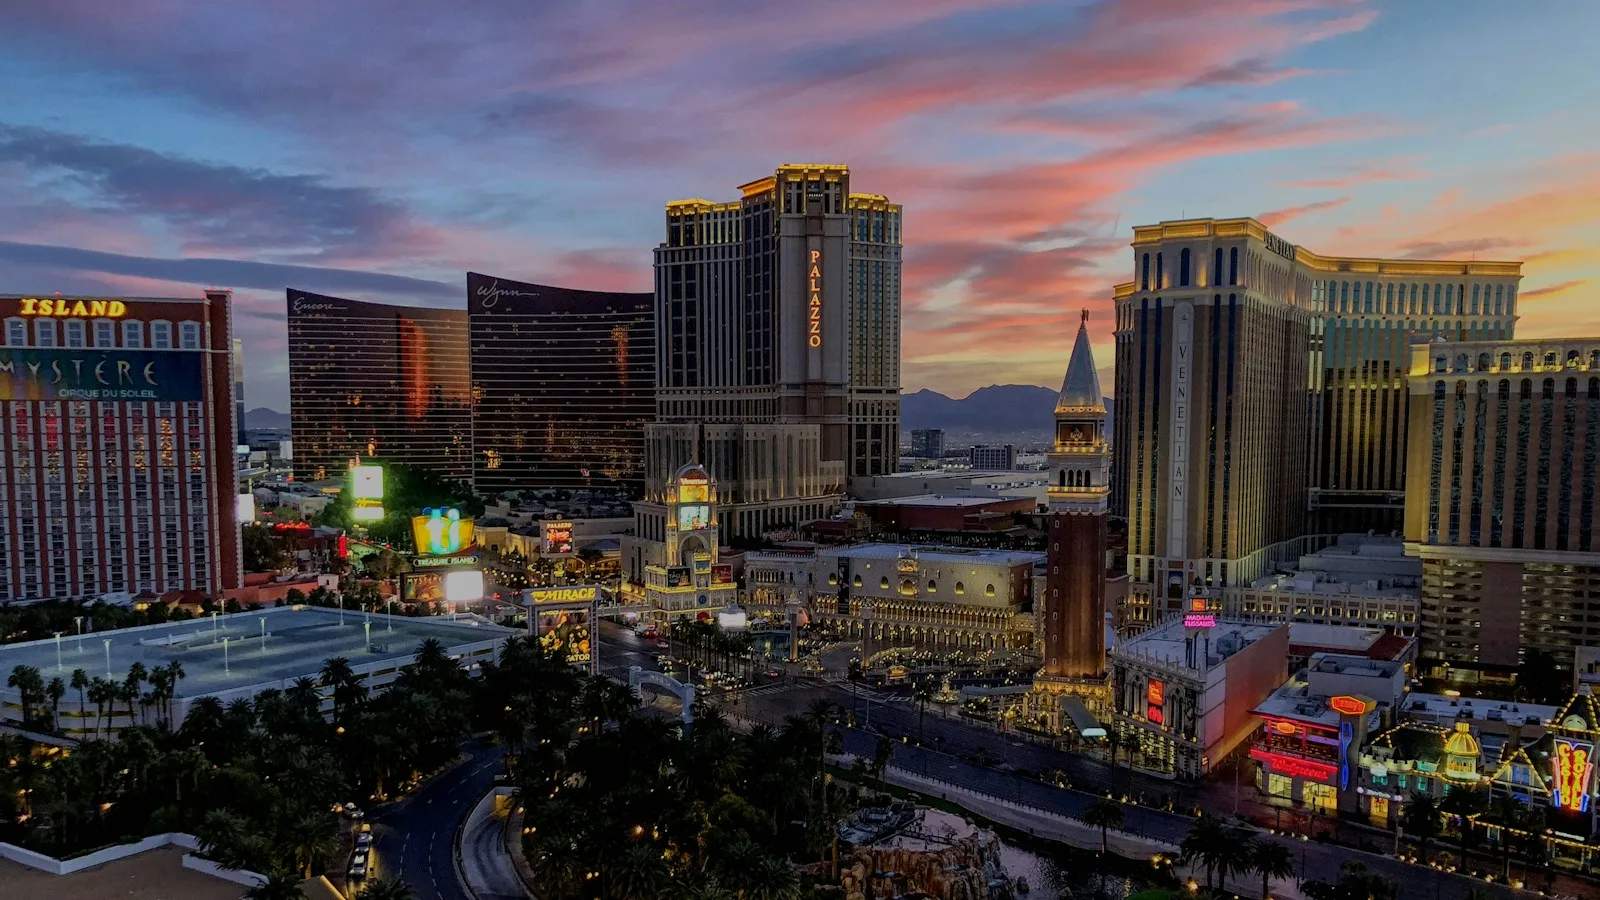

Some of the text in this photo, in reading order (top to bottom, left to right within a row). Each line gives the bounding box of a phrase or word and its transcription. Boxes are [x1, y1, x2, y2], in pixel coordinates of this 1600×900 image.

[20, 298, 127, 318] ISLAND
[293, 297, 348, 313] Encore
[476, 279, 541, 308] Wynn
[809, 250, 821, 348] PALAZZO
[59, 389, 156, 400] CIRQUE DU SOLEIL
[1174, 345, 1187, 497] VENETIAN
[425, 508, 460, 555] ti
[545, 588, 596, 601] MIRAGE
[1271, 759, 1329, 780] Walgreens
[1559, 744, 1571, 806] CASINO
[1570, 750, 1588, 810] ROYALE
